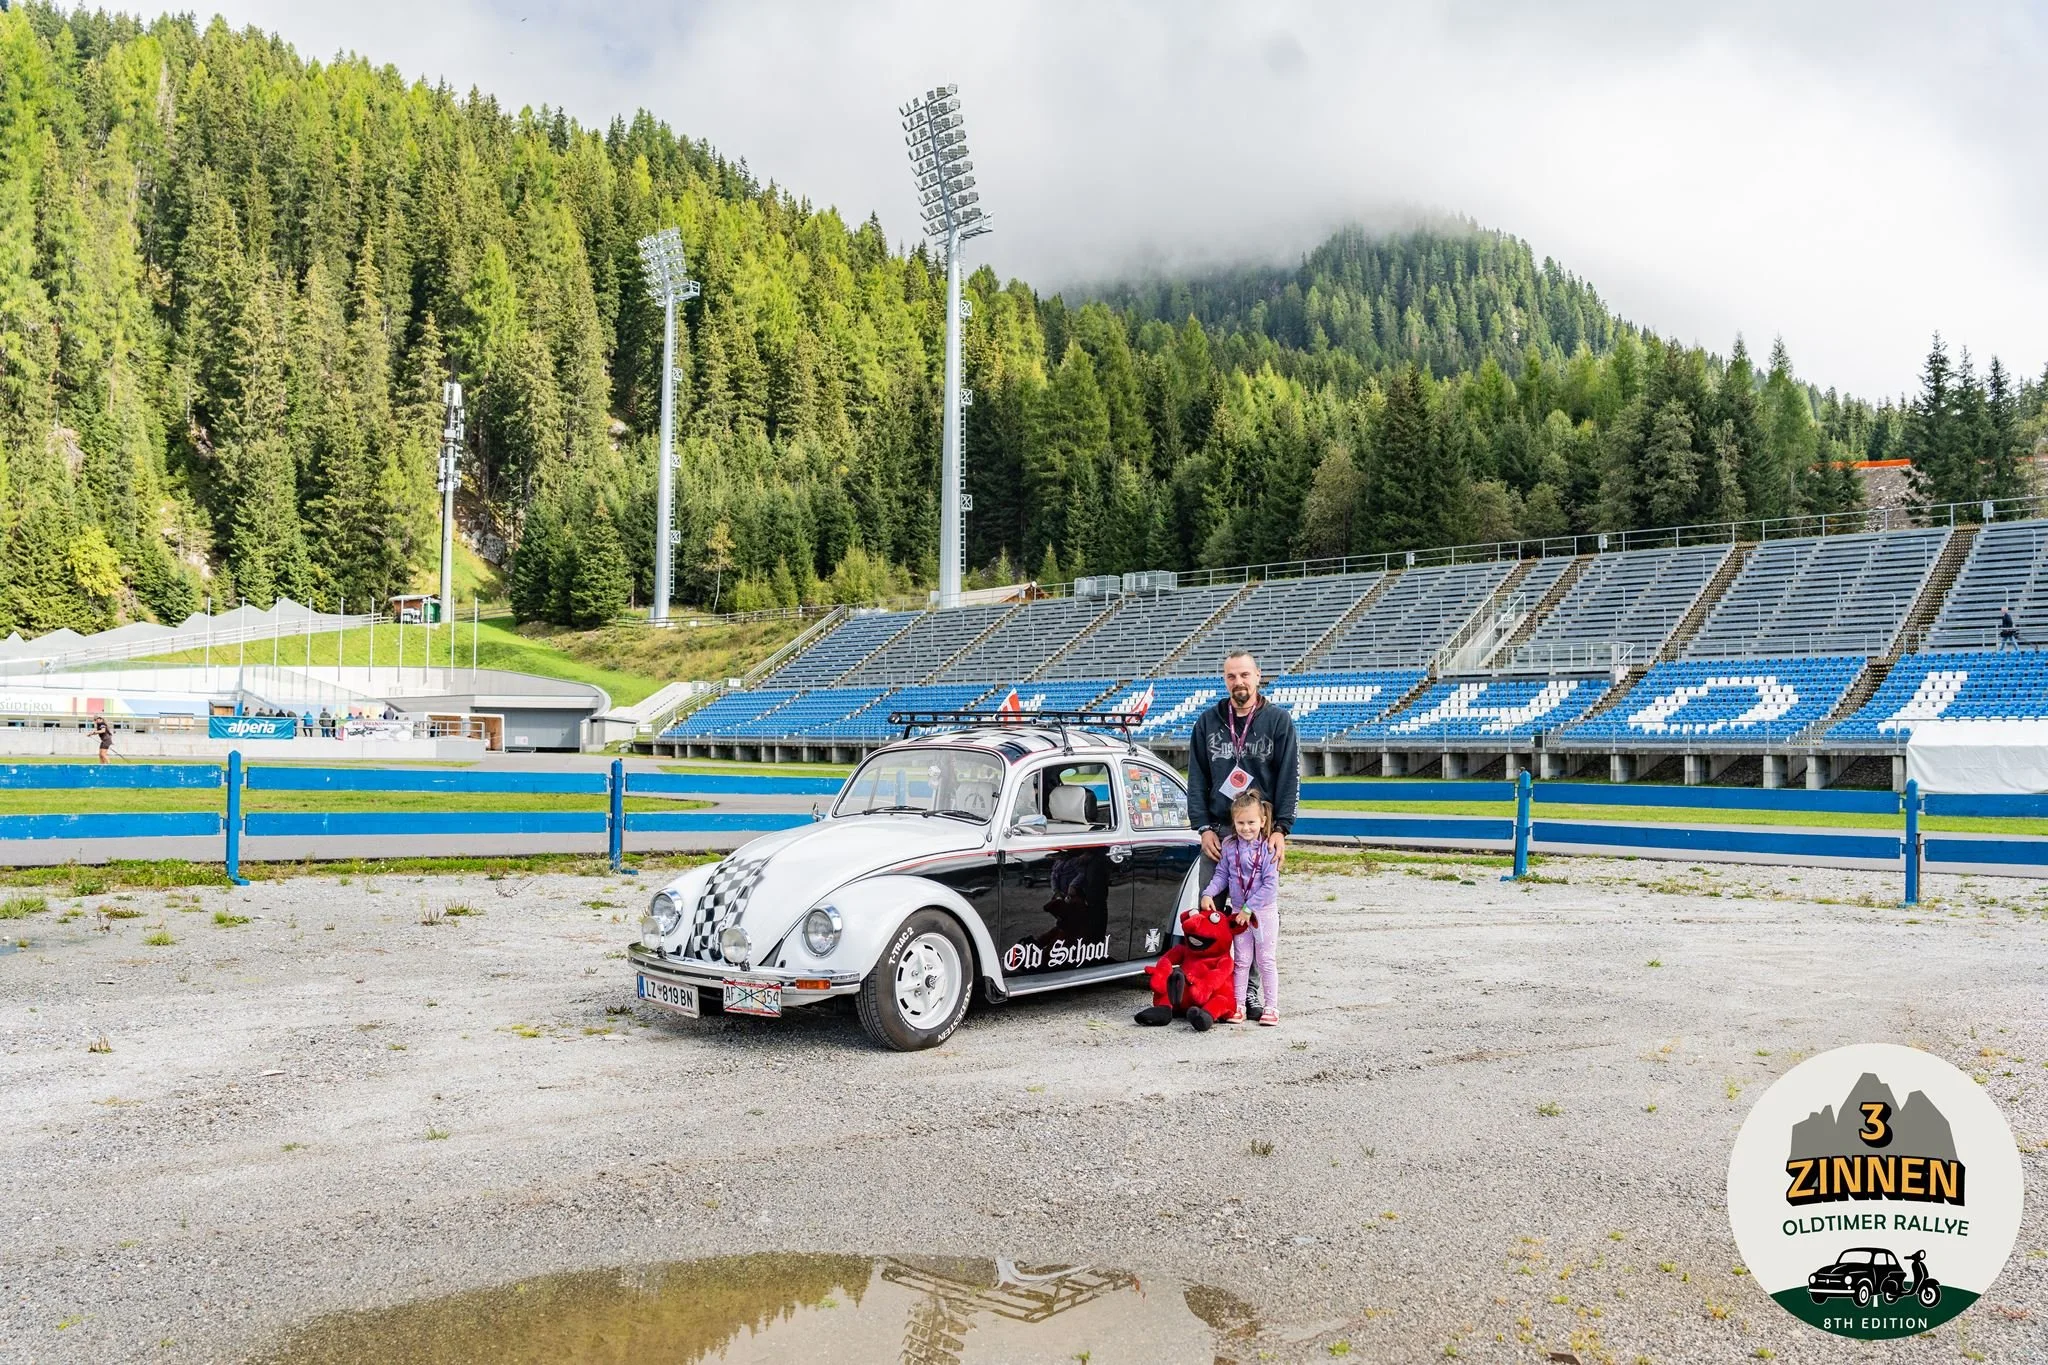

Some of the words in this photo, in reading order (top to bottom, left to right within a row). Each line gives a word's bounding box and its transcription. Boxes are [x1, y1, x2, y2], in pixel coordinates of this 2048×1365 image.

[227, 720, 276, 737] alperia
[1003, 942, 1043, 971] Old
[1047, 934, 1111, 968] School
[645, 979, 657, 999] LZ
[662, 985, 678, 1004] 819
[681, 989, 693, 1008] BN
